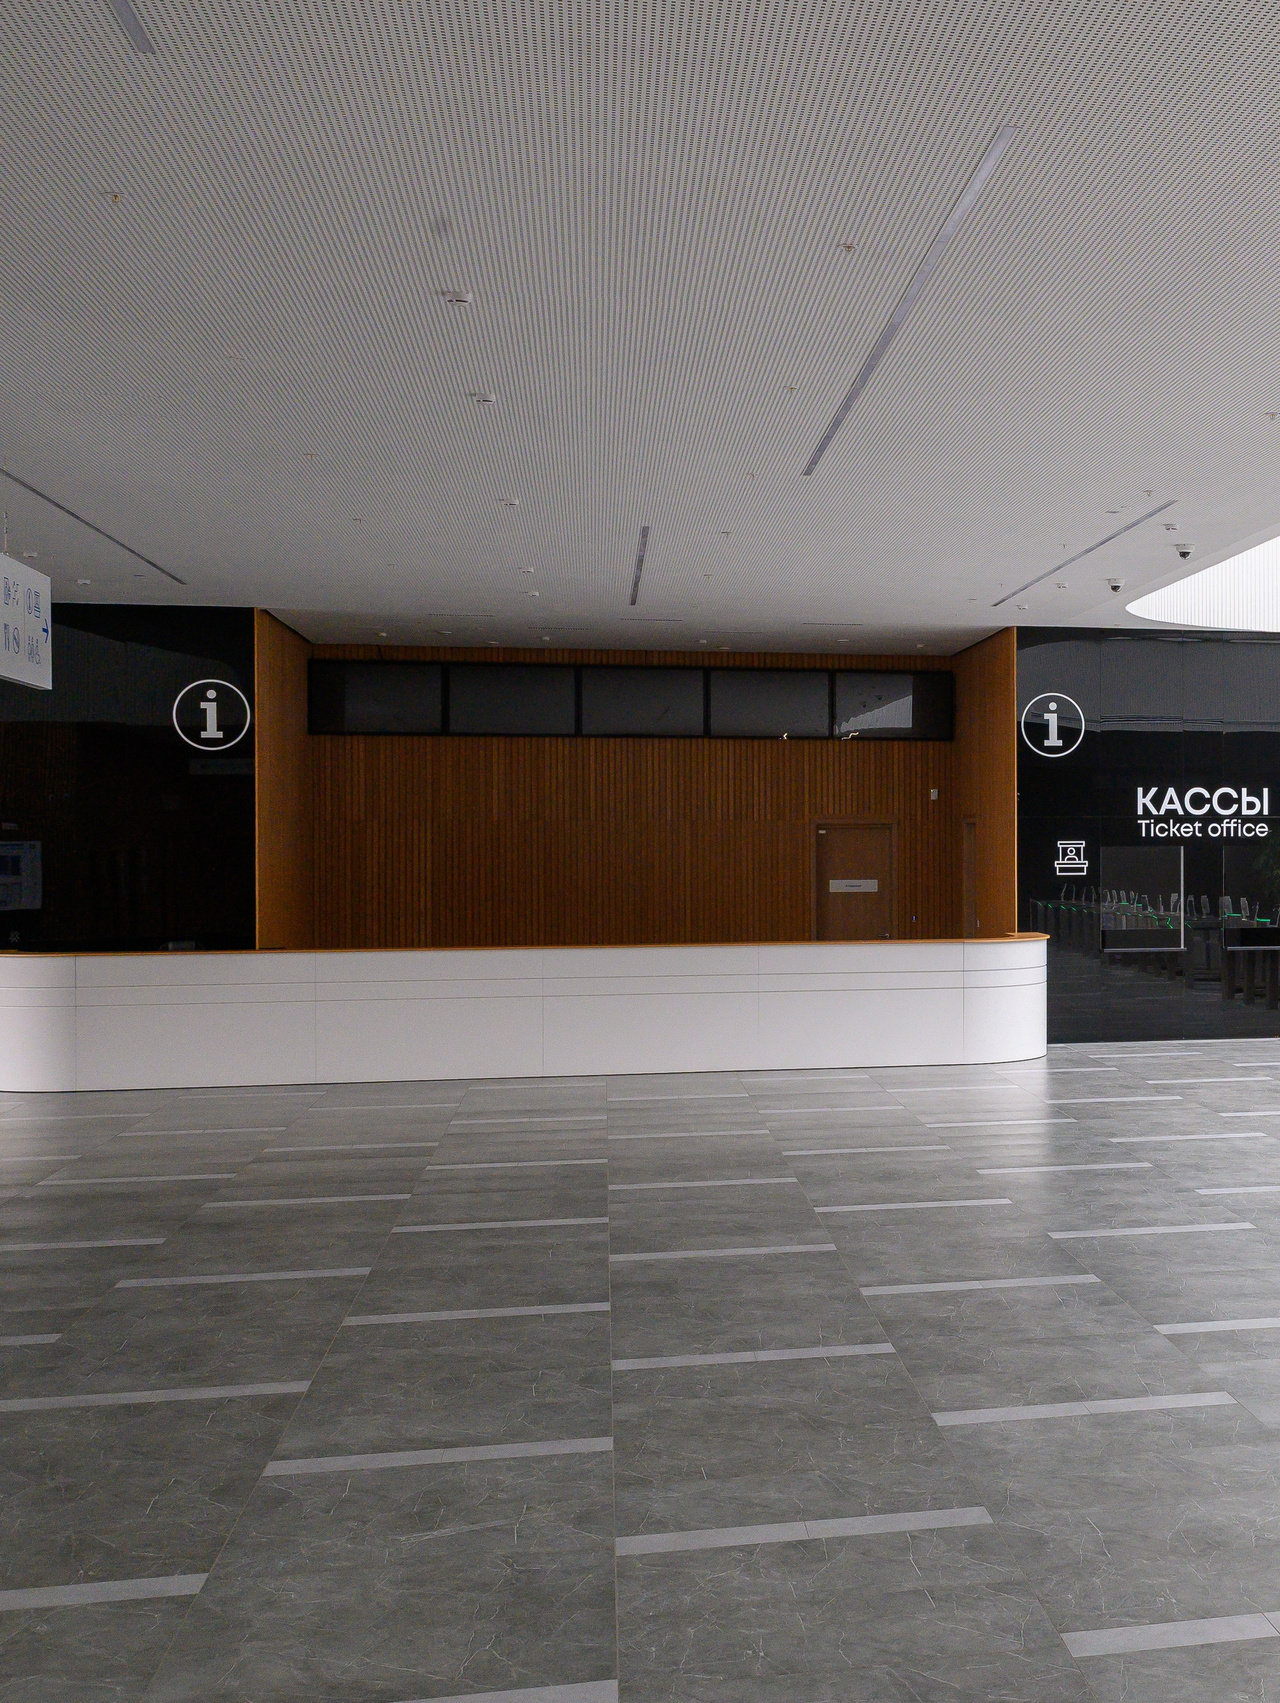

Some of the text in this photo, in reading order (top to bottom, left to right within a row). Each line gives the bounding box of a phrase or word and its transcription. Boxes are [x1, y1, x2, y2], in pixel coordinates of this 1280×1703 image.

[1137, 787, 1269, 815] КАССЫ
[1137, 819, 1269, 837] Ticket office
